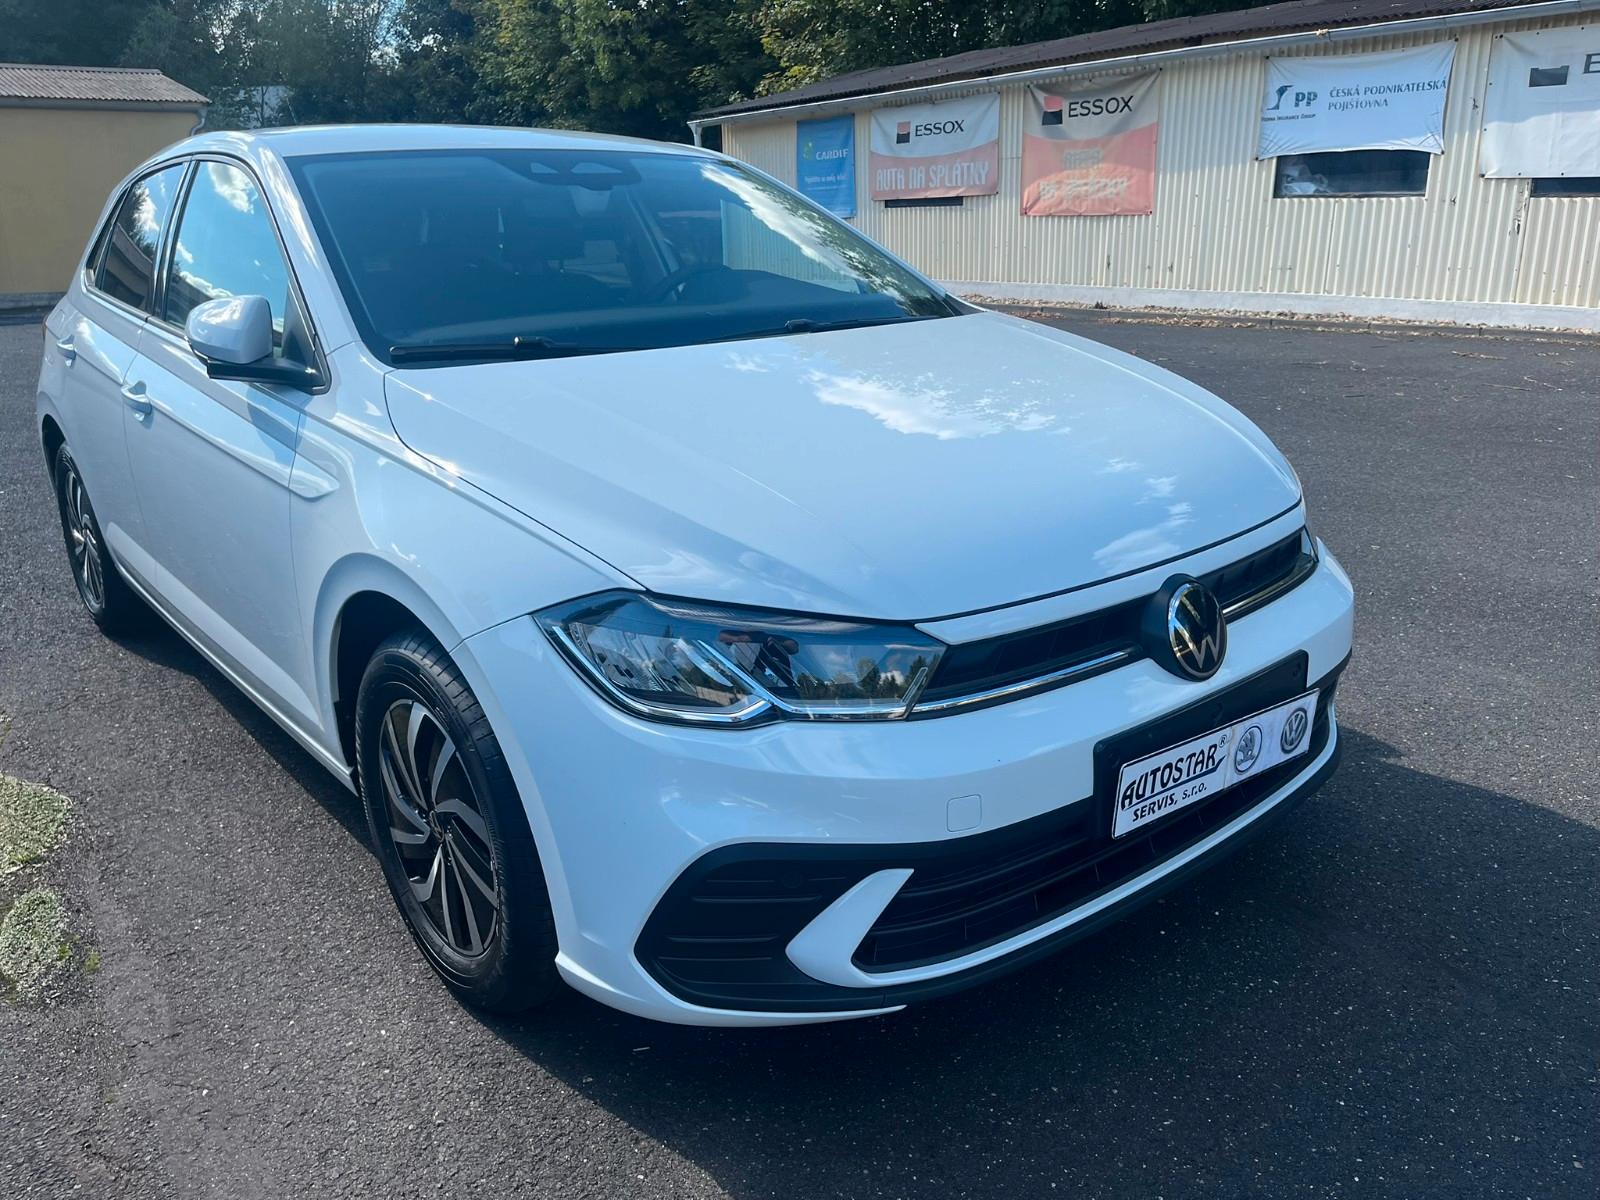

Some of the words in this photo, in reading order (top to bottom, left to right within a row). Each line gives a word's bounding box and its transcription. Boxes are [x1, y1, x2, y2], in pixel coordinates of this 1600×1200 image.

[1363, 76, 1447, 95] PODNIKATELSKÁ
[1068, 95, 1134, 118] ESSOX
[1294, 91, 1318, 107] PP
[915, 119, 964, 136] ESSOX
[815, 148, 849, 160] CARDIF
[876, 167, 905, 191] AUTA
[1133, 792, 1178, 822] SERVIS,
[1182, 782, 1207, 800] s.r.o.
